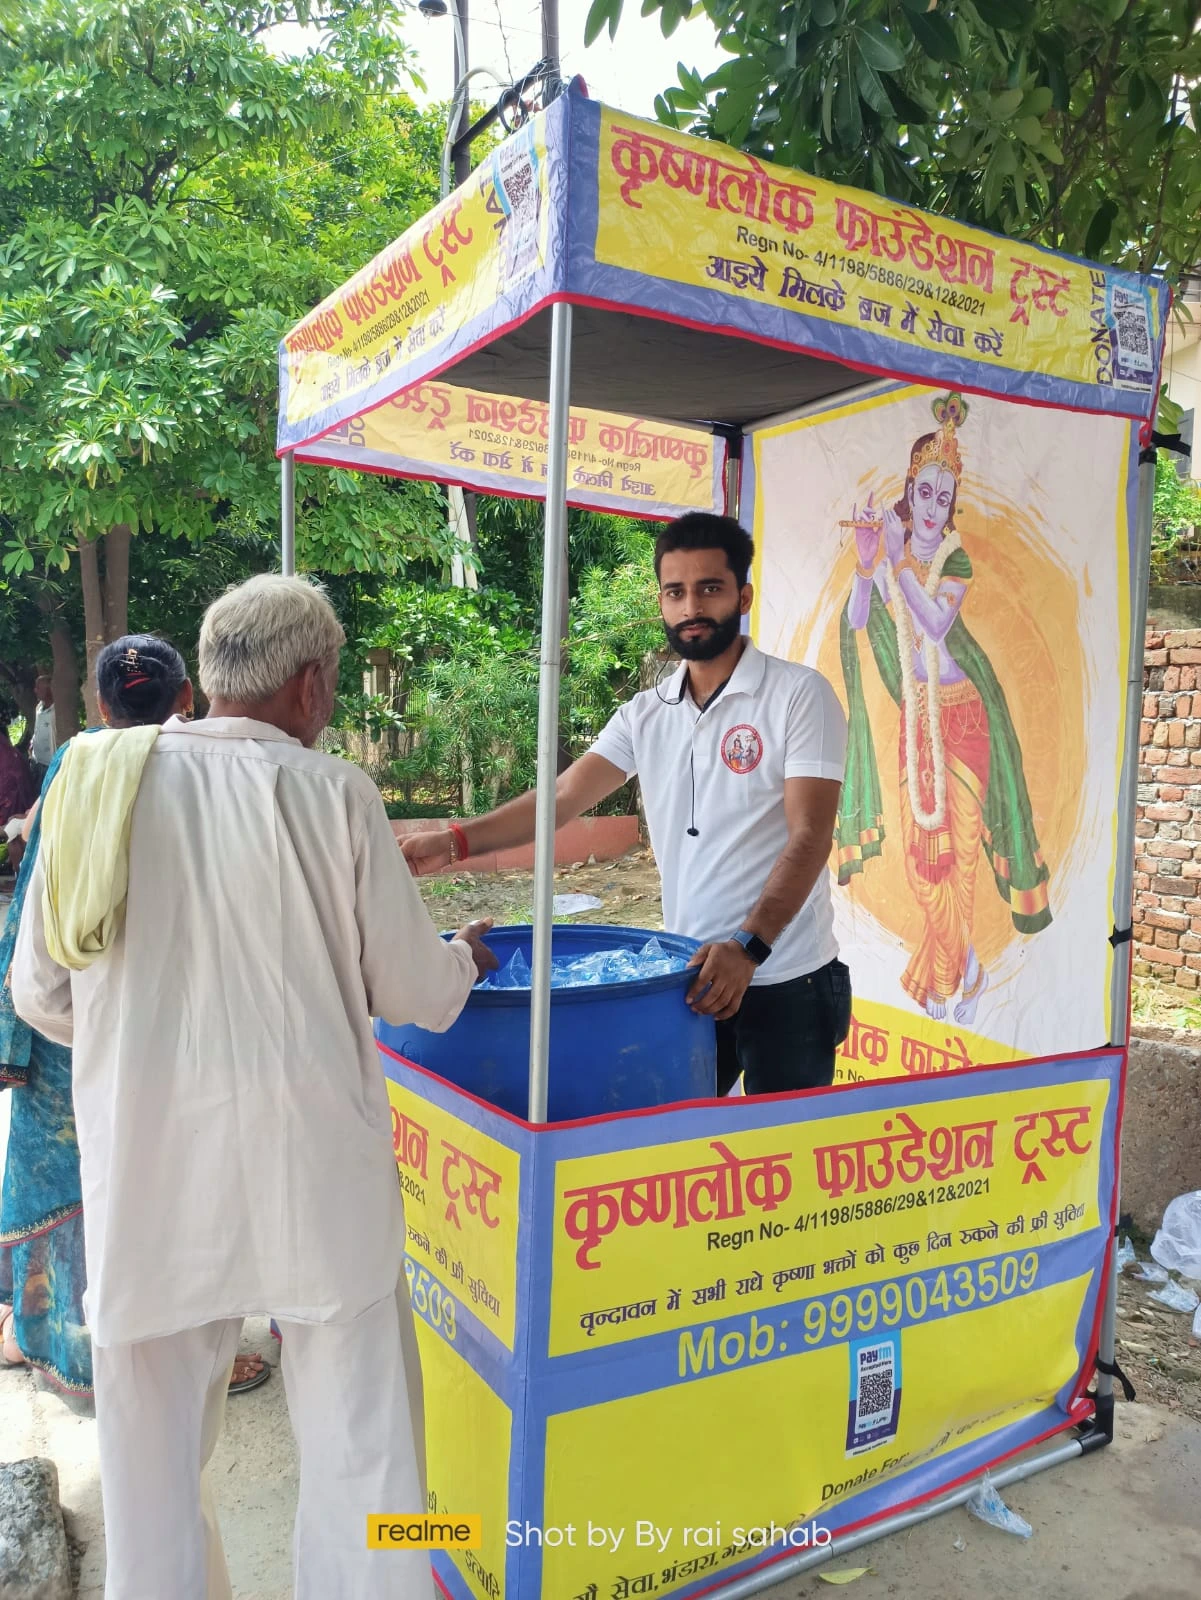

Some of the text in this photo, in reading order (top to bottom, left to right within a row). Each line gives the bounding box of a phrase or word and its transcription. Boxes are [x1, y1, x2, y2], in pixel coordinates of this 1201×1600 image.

[610, 124, 1072, 327] कृष्णलोक फाउंडेशन ट्रस्ट
[736, 225, 779, 253] Regn
[813, 249, 986, 317] 4/1198/5886/29&12&2021
[705, 255, 769, 292] आइये
[777, 266, 848, 312] मिलके
[900, 300, 920, 335] में
[926, 310, 966, 348] सेवा
[973, 327, 1004, 358] करें
[1089, 270, 1113, 386] DONATE
[440, 1138, 503, 1232] ट्रस्ट
[563, 1106, 1093, 1271] कृष्णलोक फाउंडेशन ट्रस्ट
[707, 1231, 754, 1251] Regn
[793, 1177, 991, 1233] 4/1198/5886/29&12&2021
[580, 1298, 658, 1336] वृन्दावन
[666, 1288, 682, 1311] में
[692, 1278, 727, 1306] सभी
[735, 1270, 765, 1296] राधे
[772, 1263, 817, 1293] कृष्णा
[822, 1249, 857, 1275] भक्तों
[865, 1243, 886, 1265] को
[893, 1240, 920, 1265] कुछ
[926, 1231, 953, 1254] दिन
[959, 1219, 1000, 1245] रुकने
[1006, 1215, 1025, 1235] की
[1030, 1210, 1048, 1232] फ्री
[678, 1251, 1040, 1378] Mob: 9999043509
[821, 1467, 878, 1501] Donate
